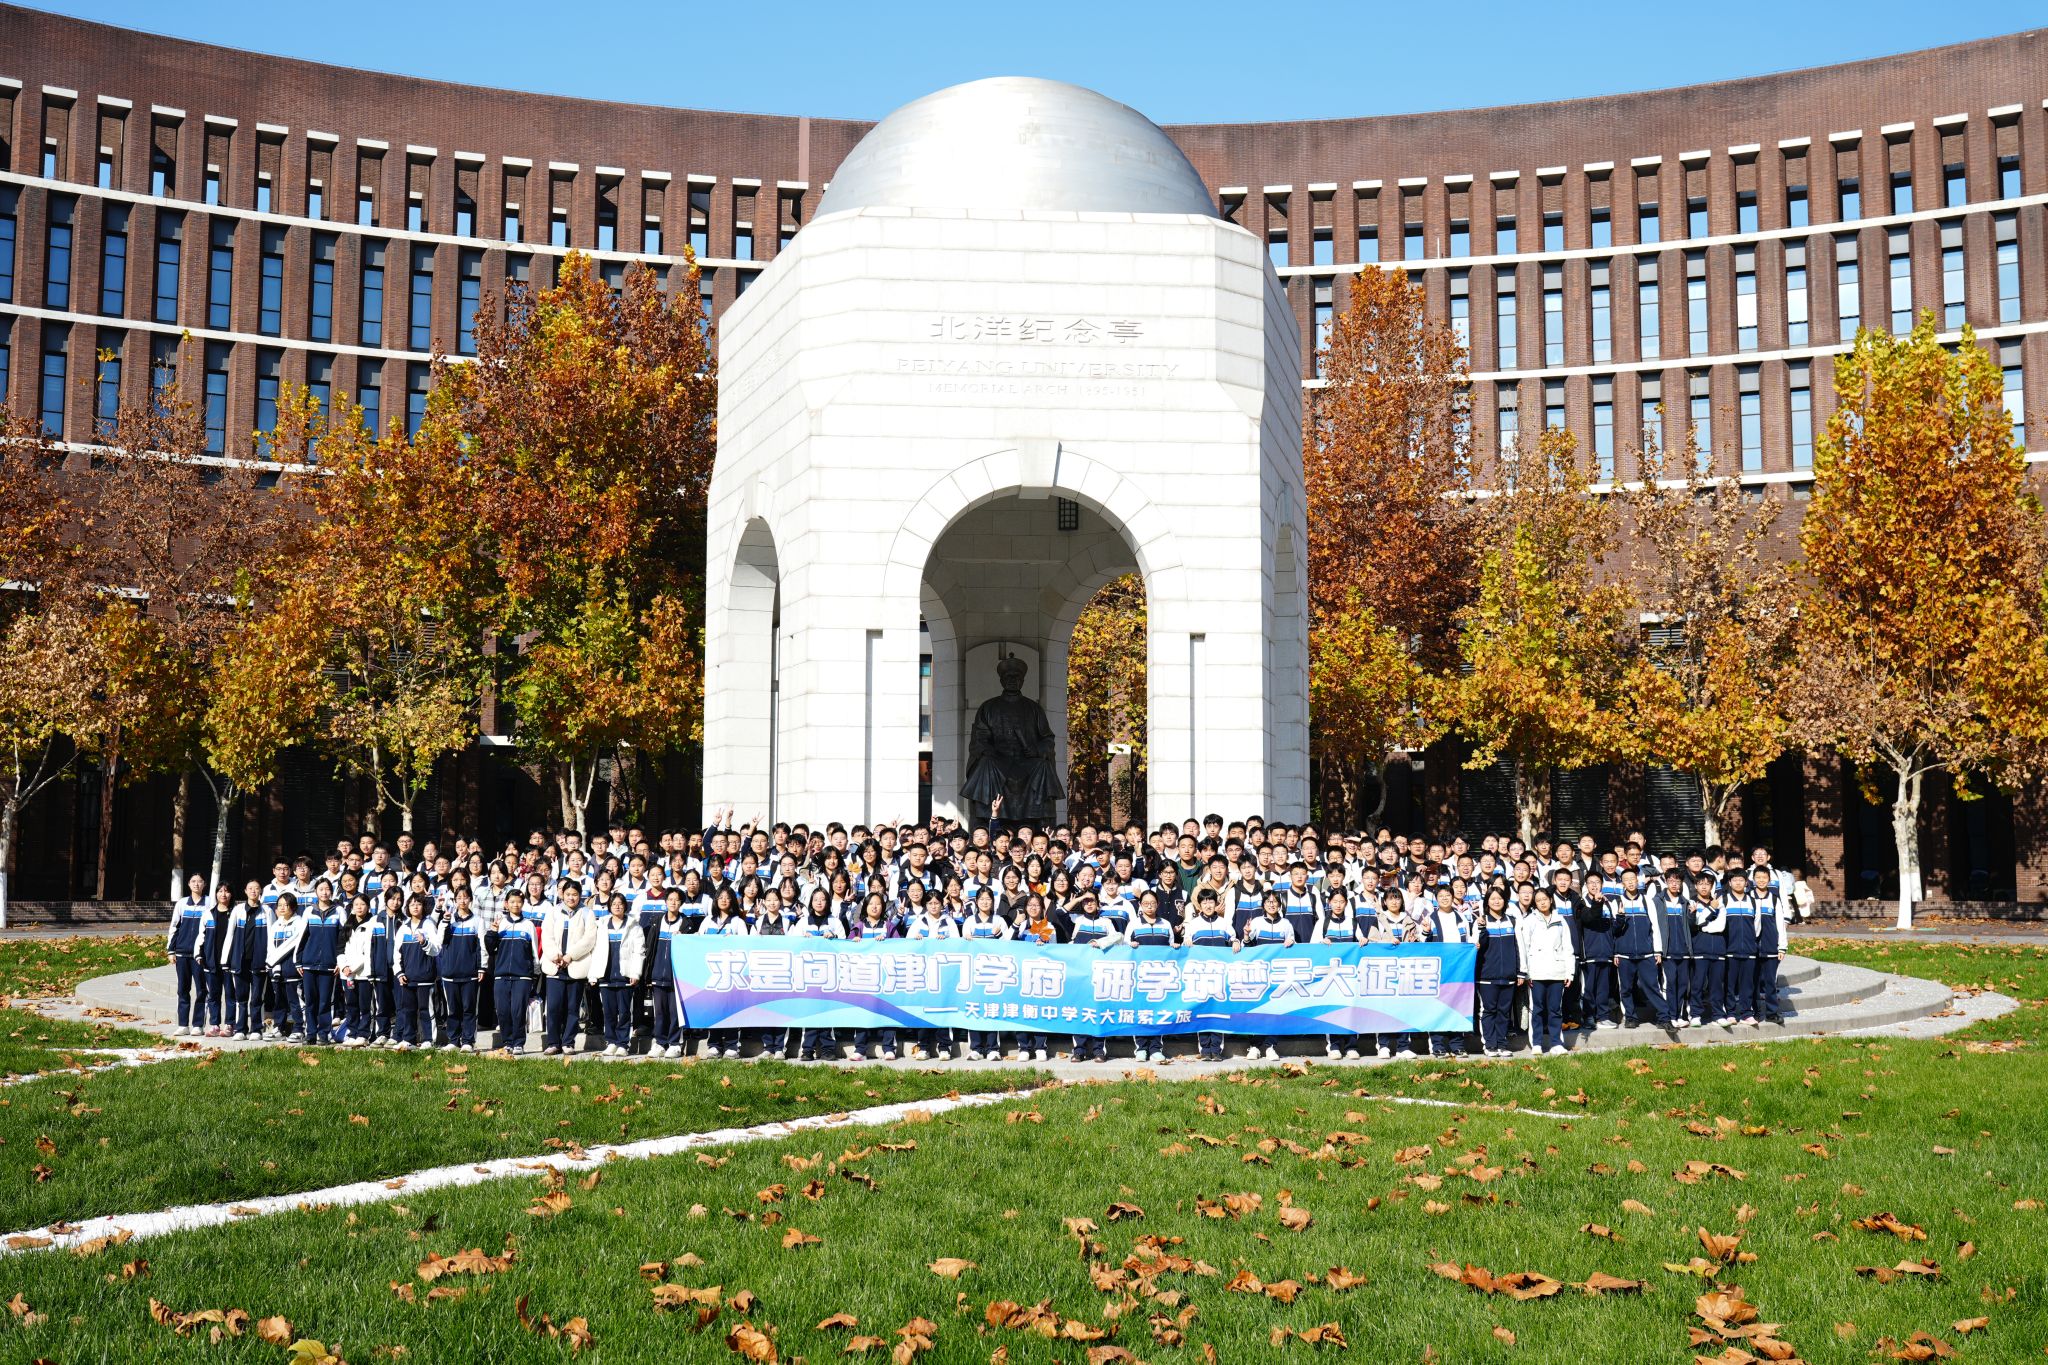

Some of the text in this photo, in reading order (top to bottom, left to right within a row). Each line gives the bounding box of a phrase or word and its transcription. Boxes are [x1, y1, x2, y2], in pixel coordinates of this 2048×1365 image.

[930, 315, 1145, 344] 北洋纪念亭
[897, 358, 1180, 377] PEIYANG UNIVERSITY
[1023, 384, 1068, 395] ARCH
[706, 951, 1443, 1003] 求是问道津门学府 研学筑梦天大征程
